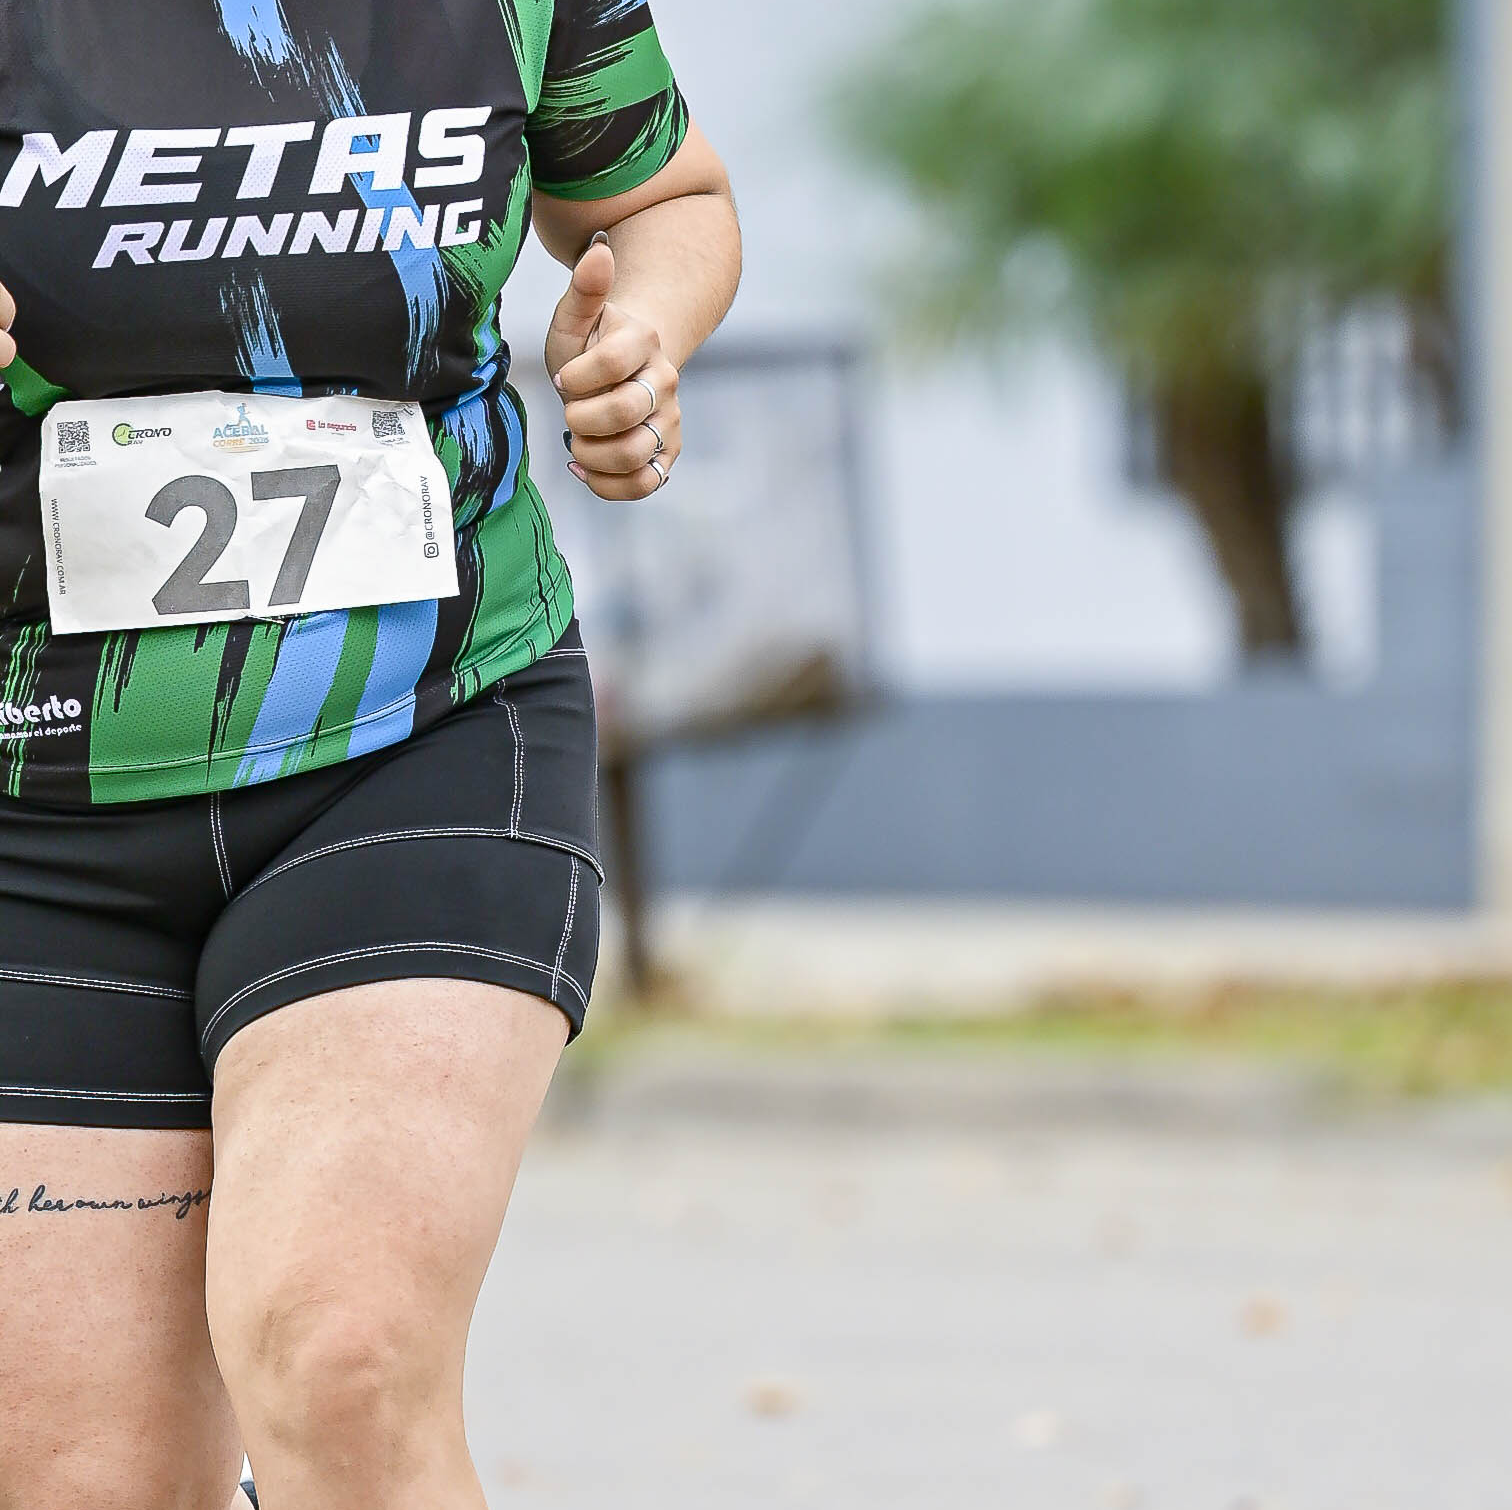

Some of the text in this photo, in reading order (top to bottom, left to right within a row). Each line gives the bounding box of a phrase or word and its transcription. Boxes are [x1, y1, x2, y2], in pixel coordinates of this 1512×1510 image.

[91, 198, 485, 269] RUNNING
[212, 423, 269, 439] ACEBAL
[419, 475, 435, 541] @CRONORAV
[144, 464, 342, 616] 27
[44, 723, 83, 737] deporte
[27, 1184, 75, 1212] her
